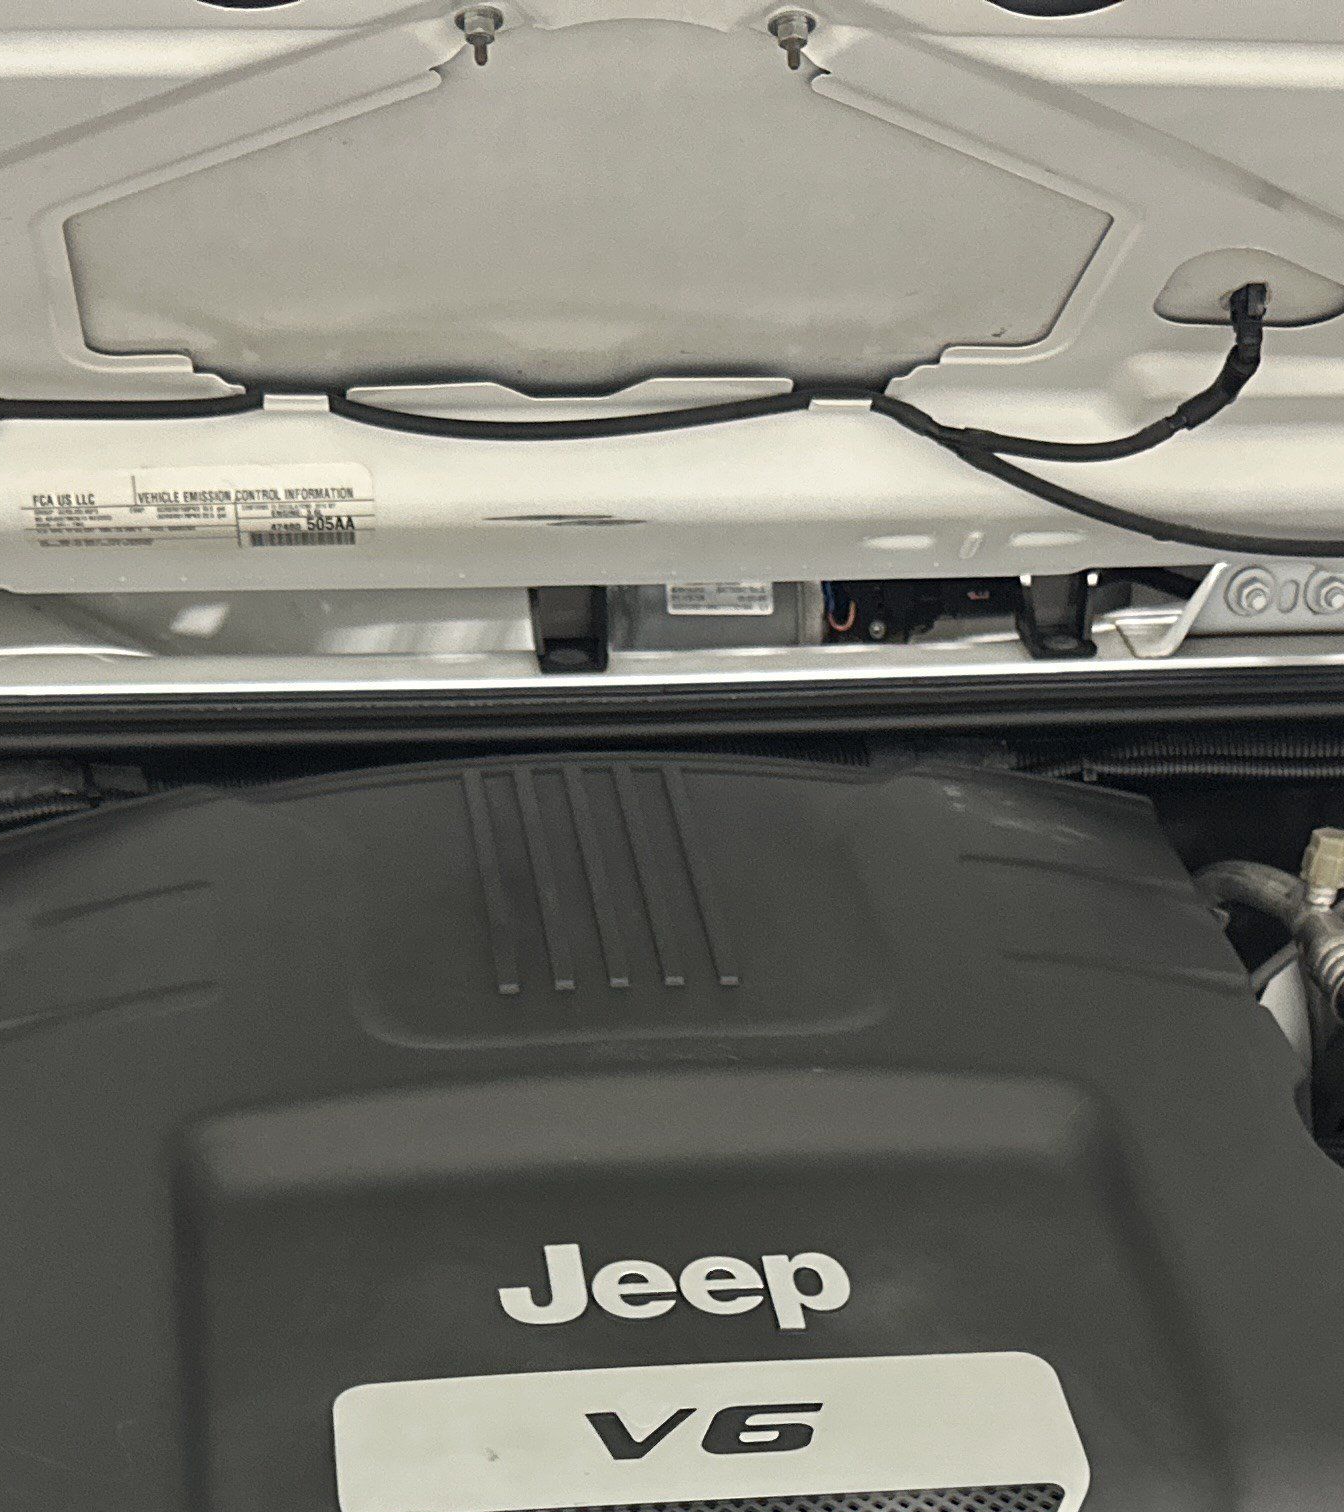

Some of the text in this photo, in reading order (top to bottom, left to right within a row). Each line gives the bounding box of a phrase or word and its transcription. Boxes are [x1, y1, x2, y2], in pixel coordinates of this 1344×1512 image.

[32, 493, 95, 507] FCA US LLC
[137, 487, 354, 504] VEHICLE EMISSION CONTROL INFORMATION
[307, 515, 355, 531] 505AA
[497, 1243, 851, 1330] Jeep
[584, 1402, 824, 1460] V6
